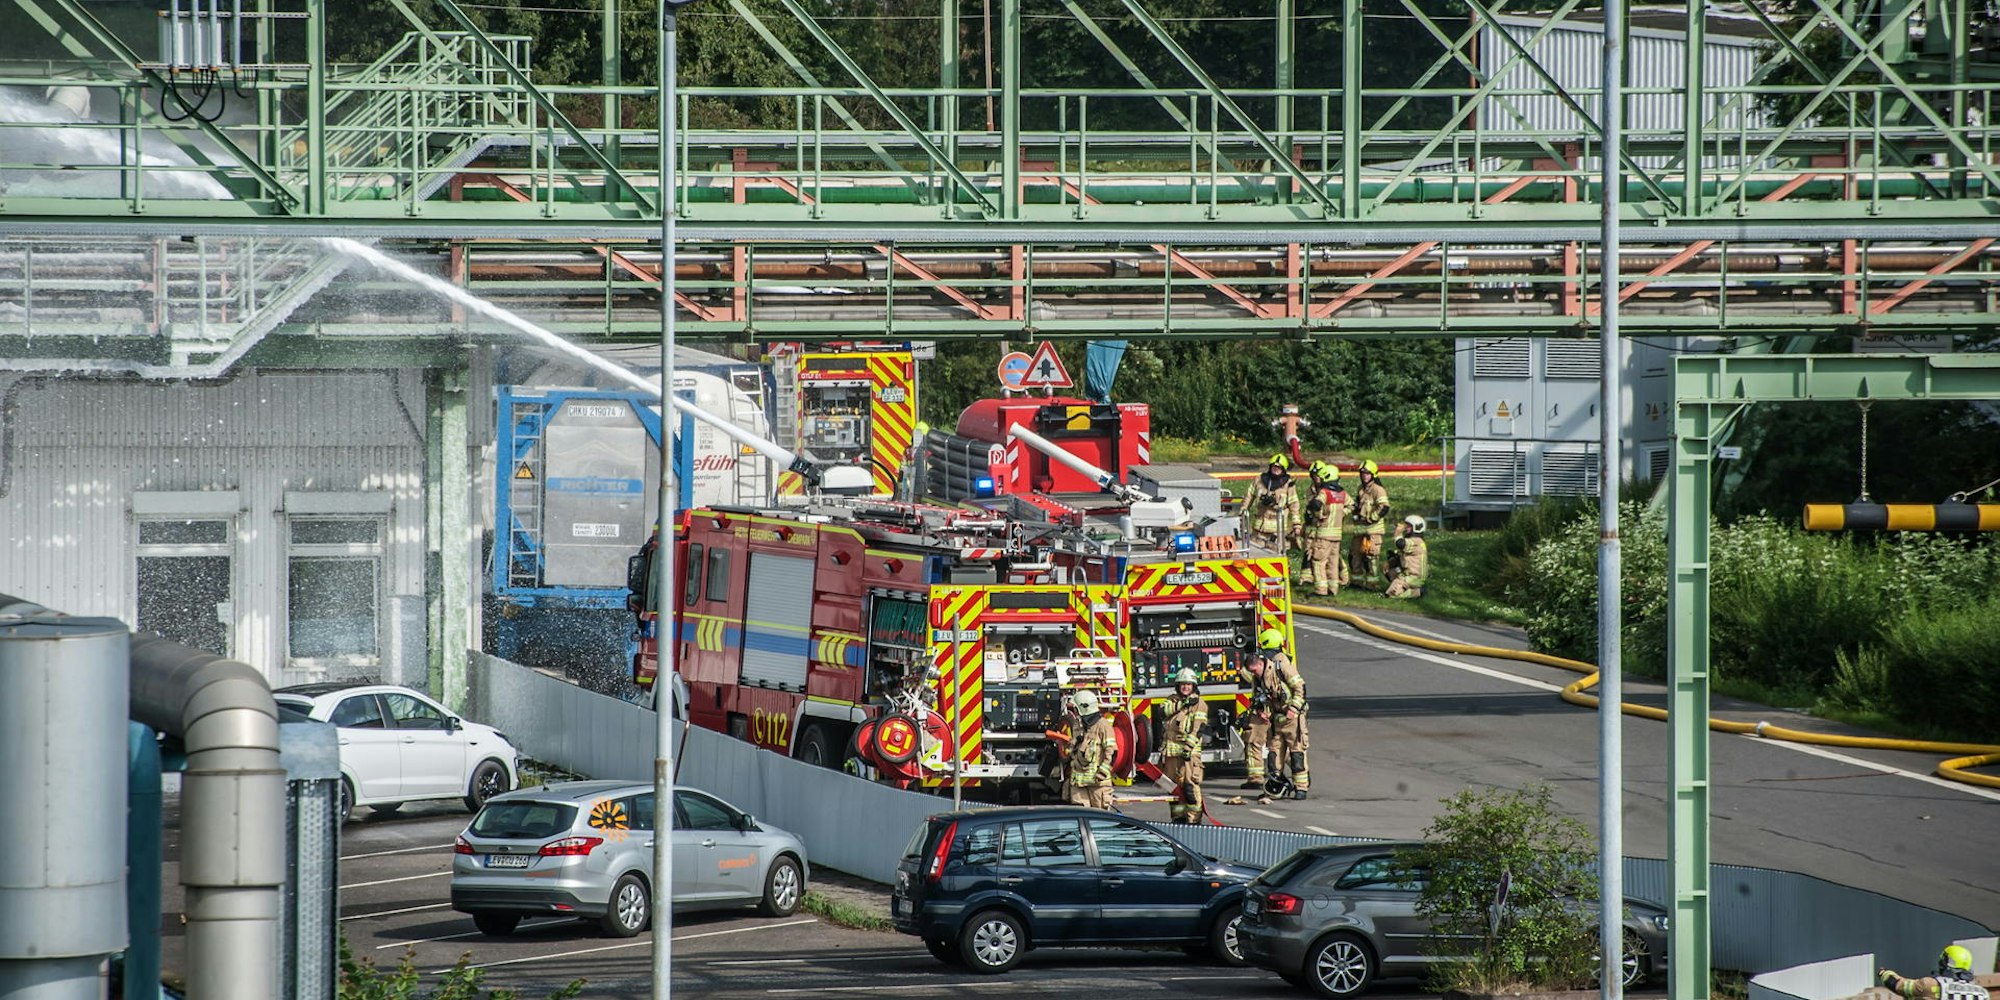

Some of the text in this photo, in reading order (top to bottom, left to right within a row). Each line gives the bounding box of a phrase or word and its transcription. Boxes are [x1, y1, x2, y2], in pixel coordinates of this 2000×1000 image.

[1168, 574, 1184, 583] LEV
[1197, 573, 1211, 582] 528
[966, 631, 978, 639] 112
[767, 711, 787, 746] 112
